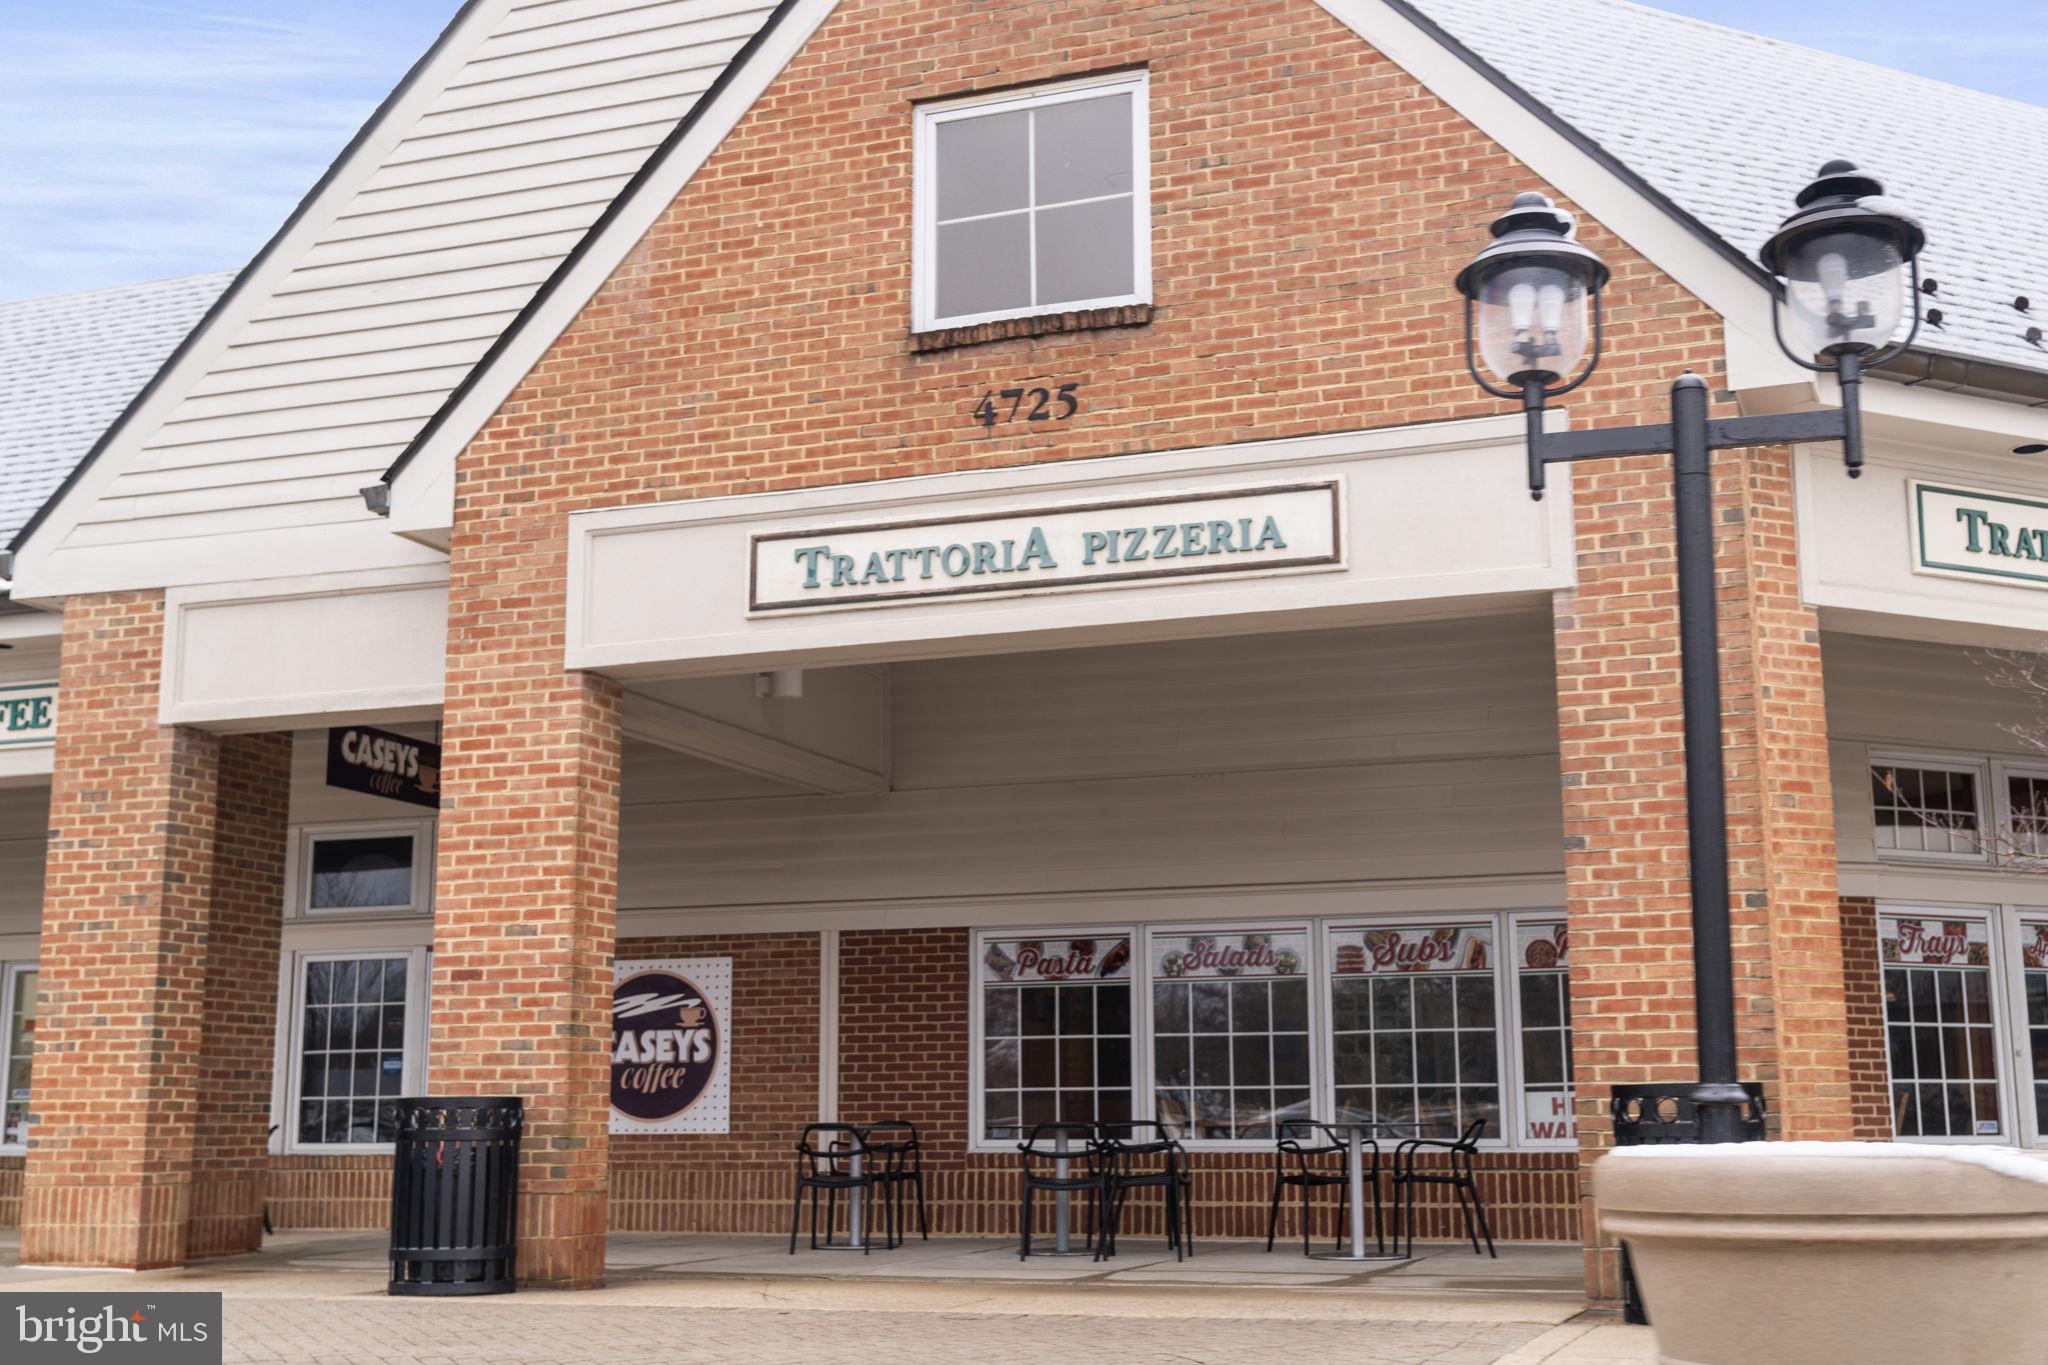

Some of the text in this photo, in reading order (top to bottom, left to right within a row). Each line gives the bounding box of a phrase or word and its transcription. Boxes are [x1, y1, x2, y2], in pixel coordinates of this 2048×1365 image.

[973, 383, 1078, 426] 4725
[794, 515, 1287, 589] TRATTORIA PIZZERIA
[341, 730, 419, 778] CASEYS
[1017, 949, 1096, 976] Pasta
[1182, 942, 1278, 974] Salads
[1372, 933, 1455, 972] Subs
[1899, 923, 1968, 964] Trays
[612, 1029, 711, 1063] ASEYS
[620, 1063, 686, 1093] coffee
